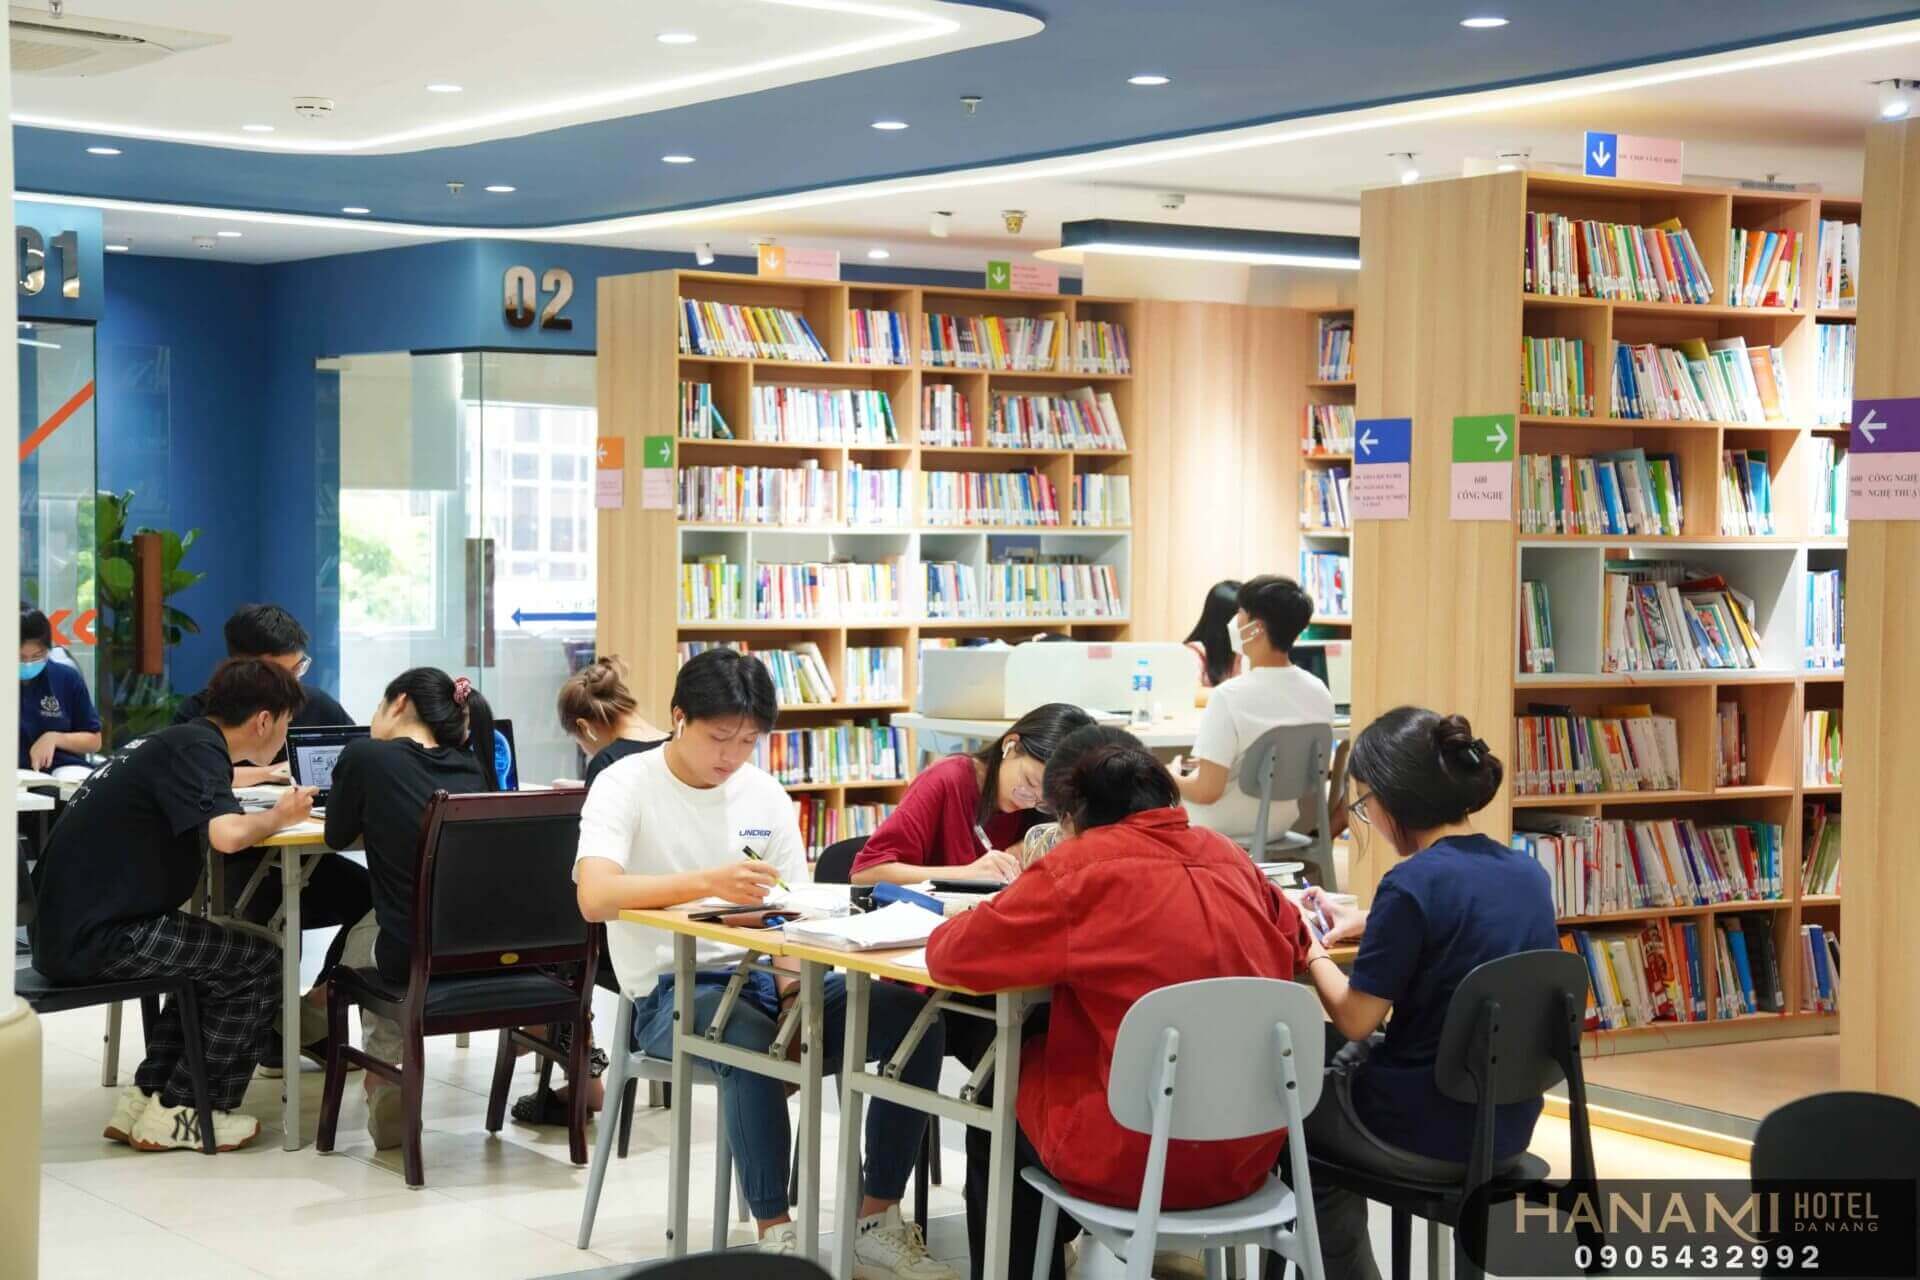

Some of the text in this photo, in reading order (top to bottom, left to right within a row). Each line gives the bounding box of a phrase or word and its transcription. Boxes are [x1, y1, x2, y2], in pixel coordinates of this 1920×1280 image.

[16, 225, 80, 298] 01
[503, 265, 573, 331] 02
[1894, 487, 1920, 499] THUẬ
